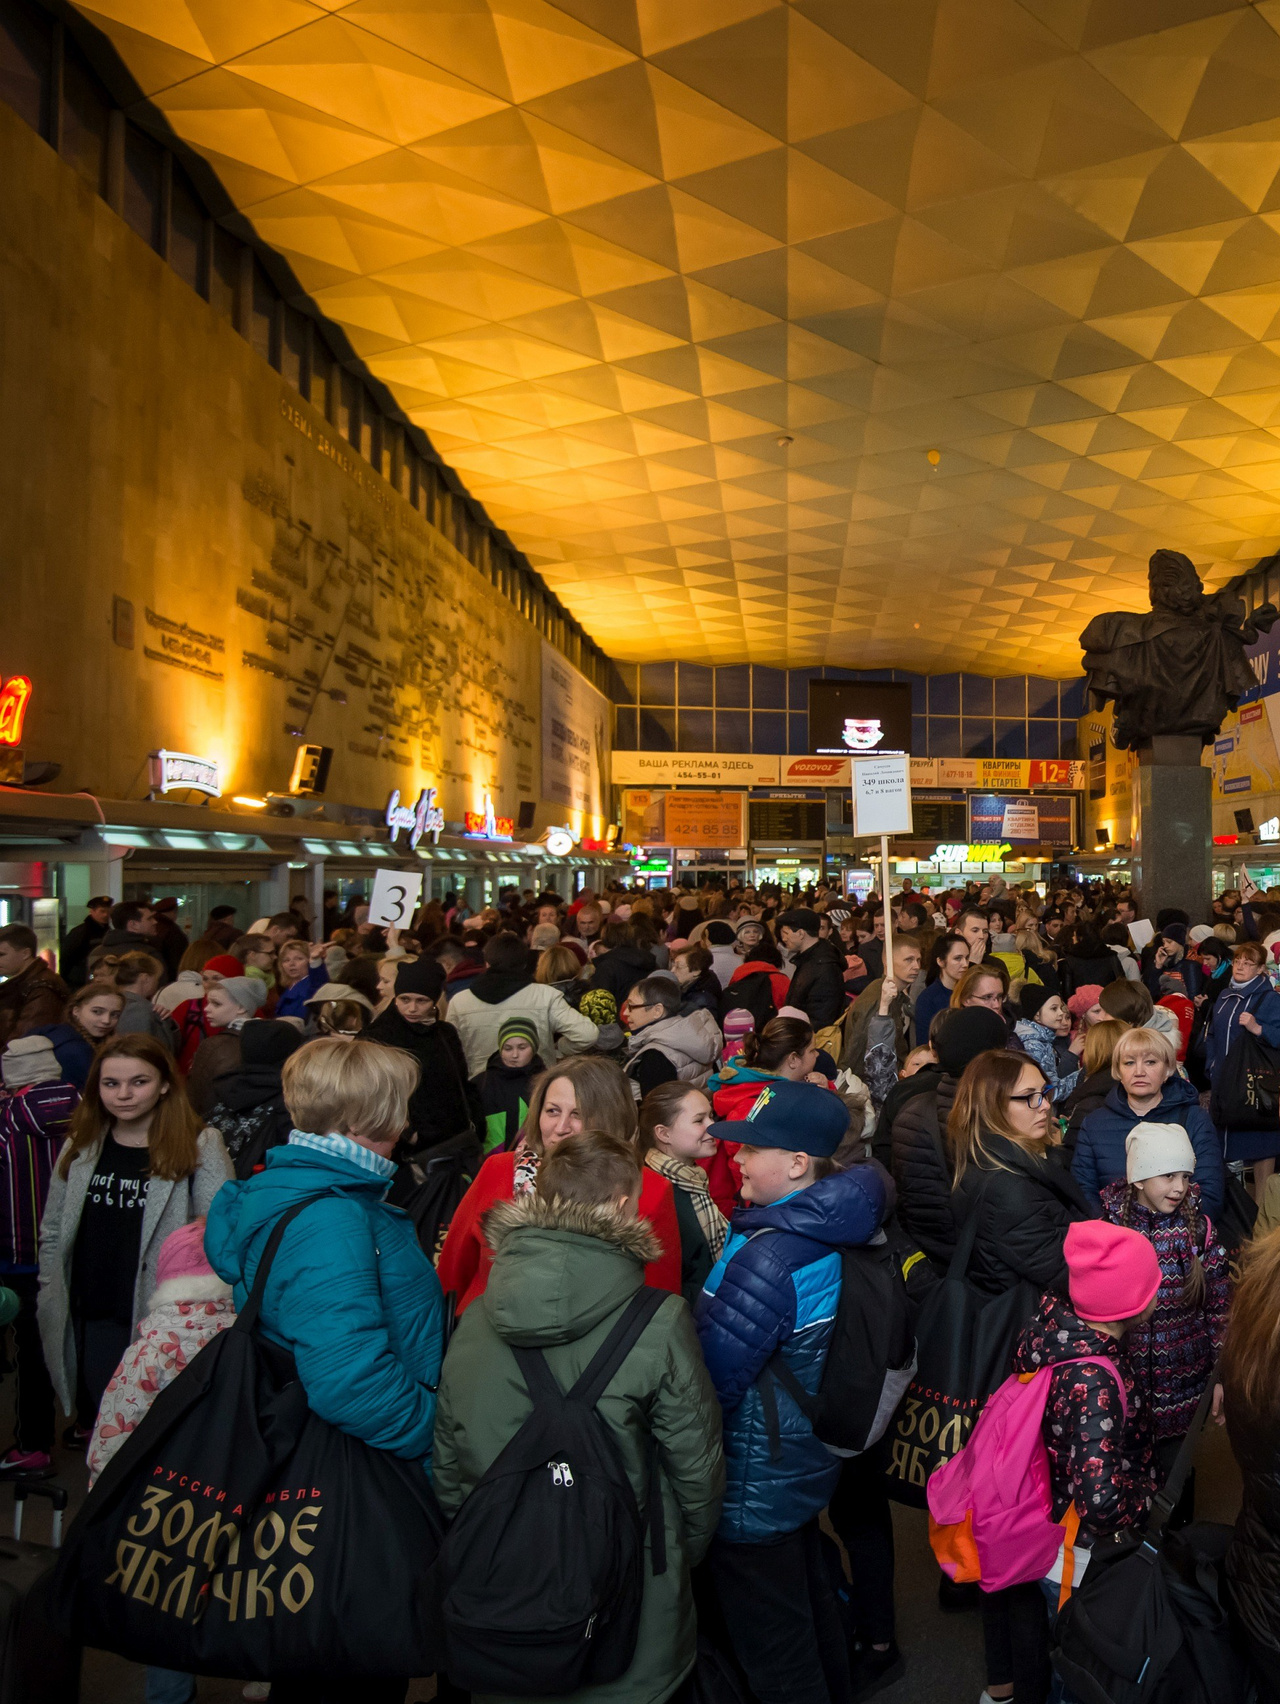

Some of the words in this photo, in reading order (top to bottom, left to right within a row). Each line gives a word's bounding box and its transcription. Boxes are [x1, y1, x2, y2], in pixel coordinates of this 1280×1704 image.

[639, 759, 669, 768] ВАША
[671, 760, 719, 769] РЕКЛАМА
[722, 761, 754, 770] ЗДЕСЬ
[909, 760, 934, 768] ЕРБУРГА
[982, 761, 1021, 770] КВАРТИРЫ
[993, 770, 1021, 778] ФИНИШЕ
[862, 778, 876, 787] 349
[878, 777, 905, 785] школа
[983, 778, 988, 787] И
[991, 778, 1022, 788] СТАРТЕ!
[674, 824, 698, 834] 424
[702, 824, 719, 835] 85
[722, 824, 738, 835] 85
[930, 841, 1012, 863] SUBWAY
[380, 885, 408, 923] 3
[91, 1172, 115, 1189] not
[119, 1178, 140, 1200] my
[153, 1465, 228, 1502] РУССКИ
[104, 1539, 315, 1624] ЯБЛЧКО
